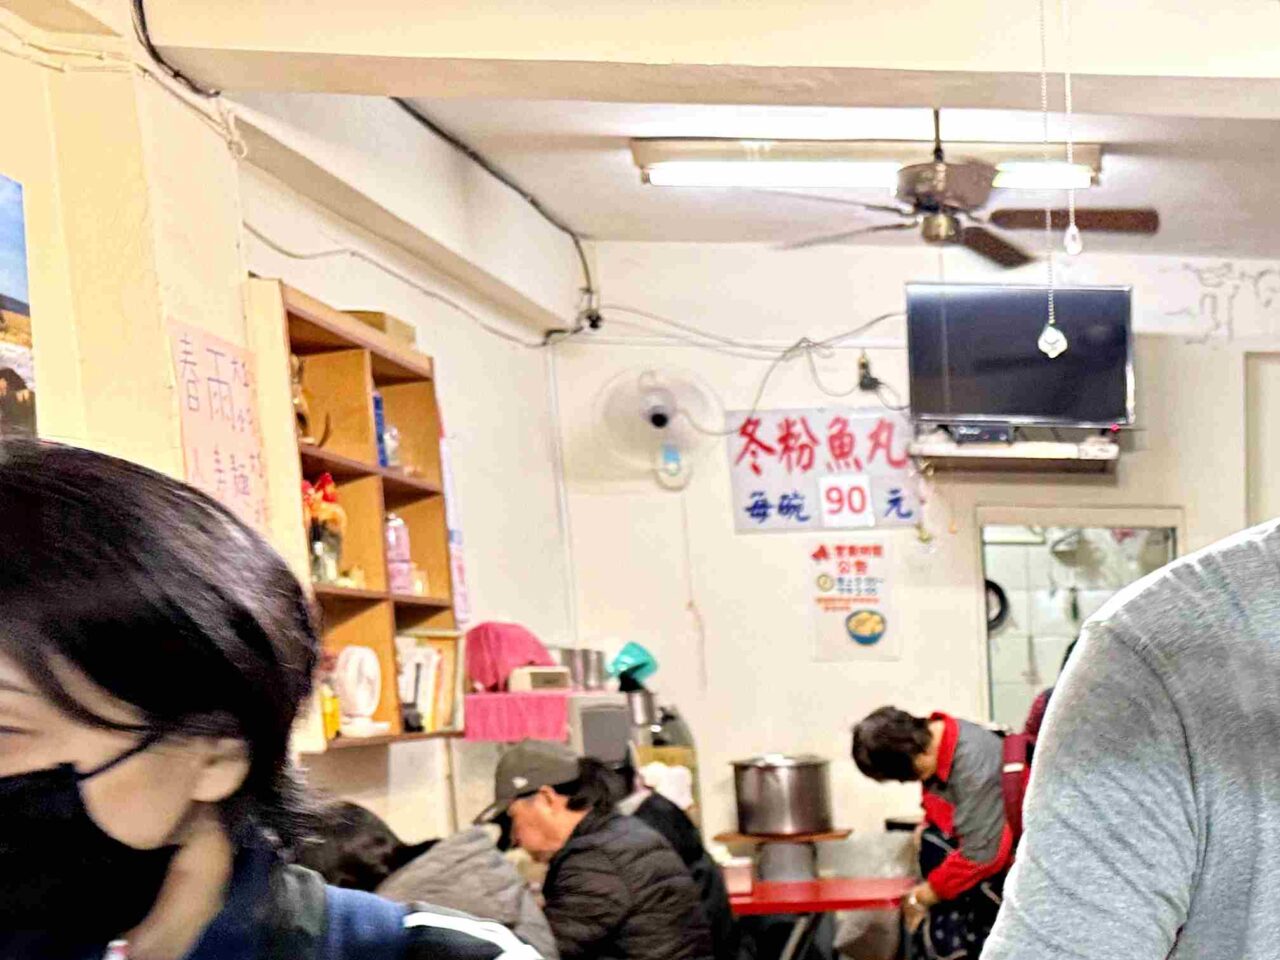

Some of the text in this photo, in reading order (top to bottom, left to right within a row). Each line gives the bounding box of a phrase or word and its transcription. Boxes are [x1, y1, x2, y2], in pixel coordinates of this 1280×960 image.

[734, 415, 910, 476] 冬粉魚丸
[745, 485, 913, 524] 每碗 90 元
